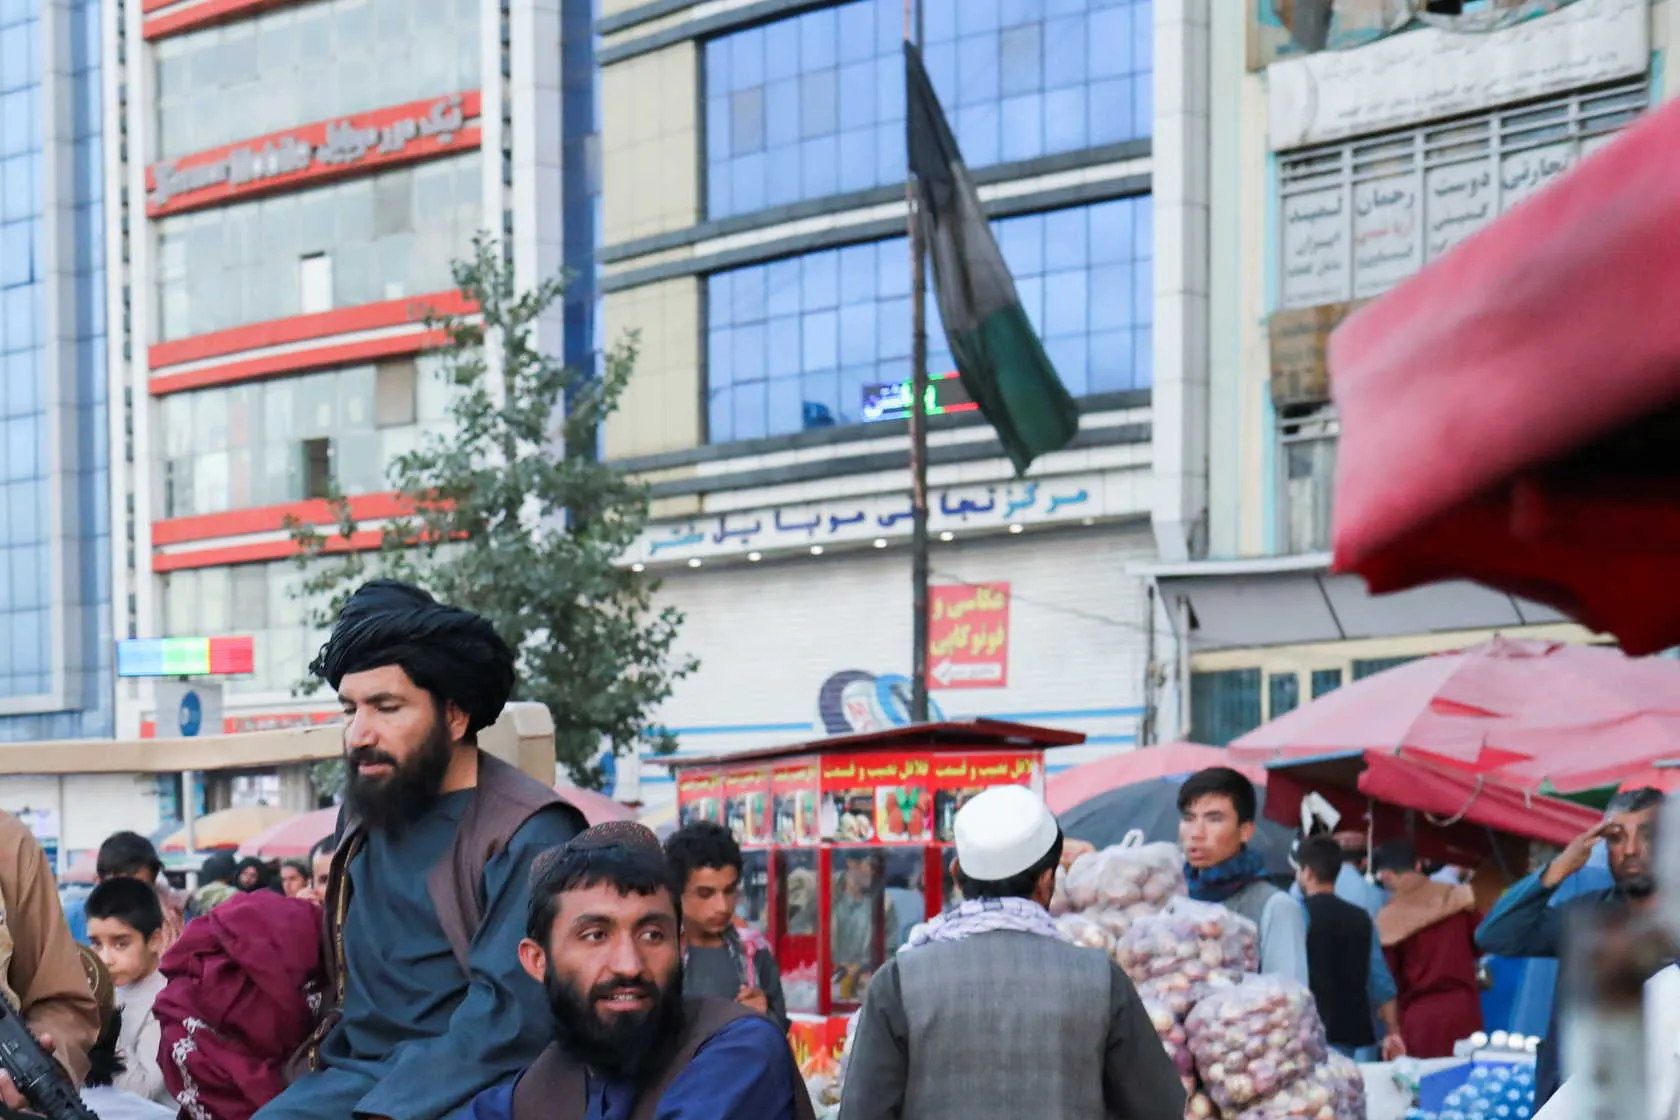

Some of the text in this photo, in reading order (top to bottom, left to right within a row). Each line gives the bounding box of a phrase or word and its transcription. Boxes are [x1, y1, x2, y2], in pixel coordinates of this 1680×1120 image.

[877, 487, 996, 528] تجاتی
[1003, 481, 1089, 520] مرکز
[712, 510, 866, 545] موبایل
[1011, 758, 1034, 780] لافل
